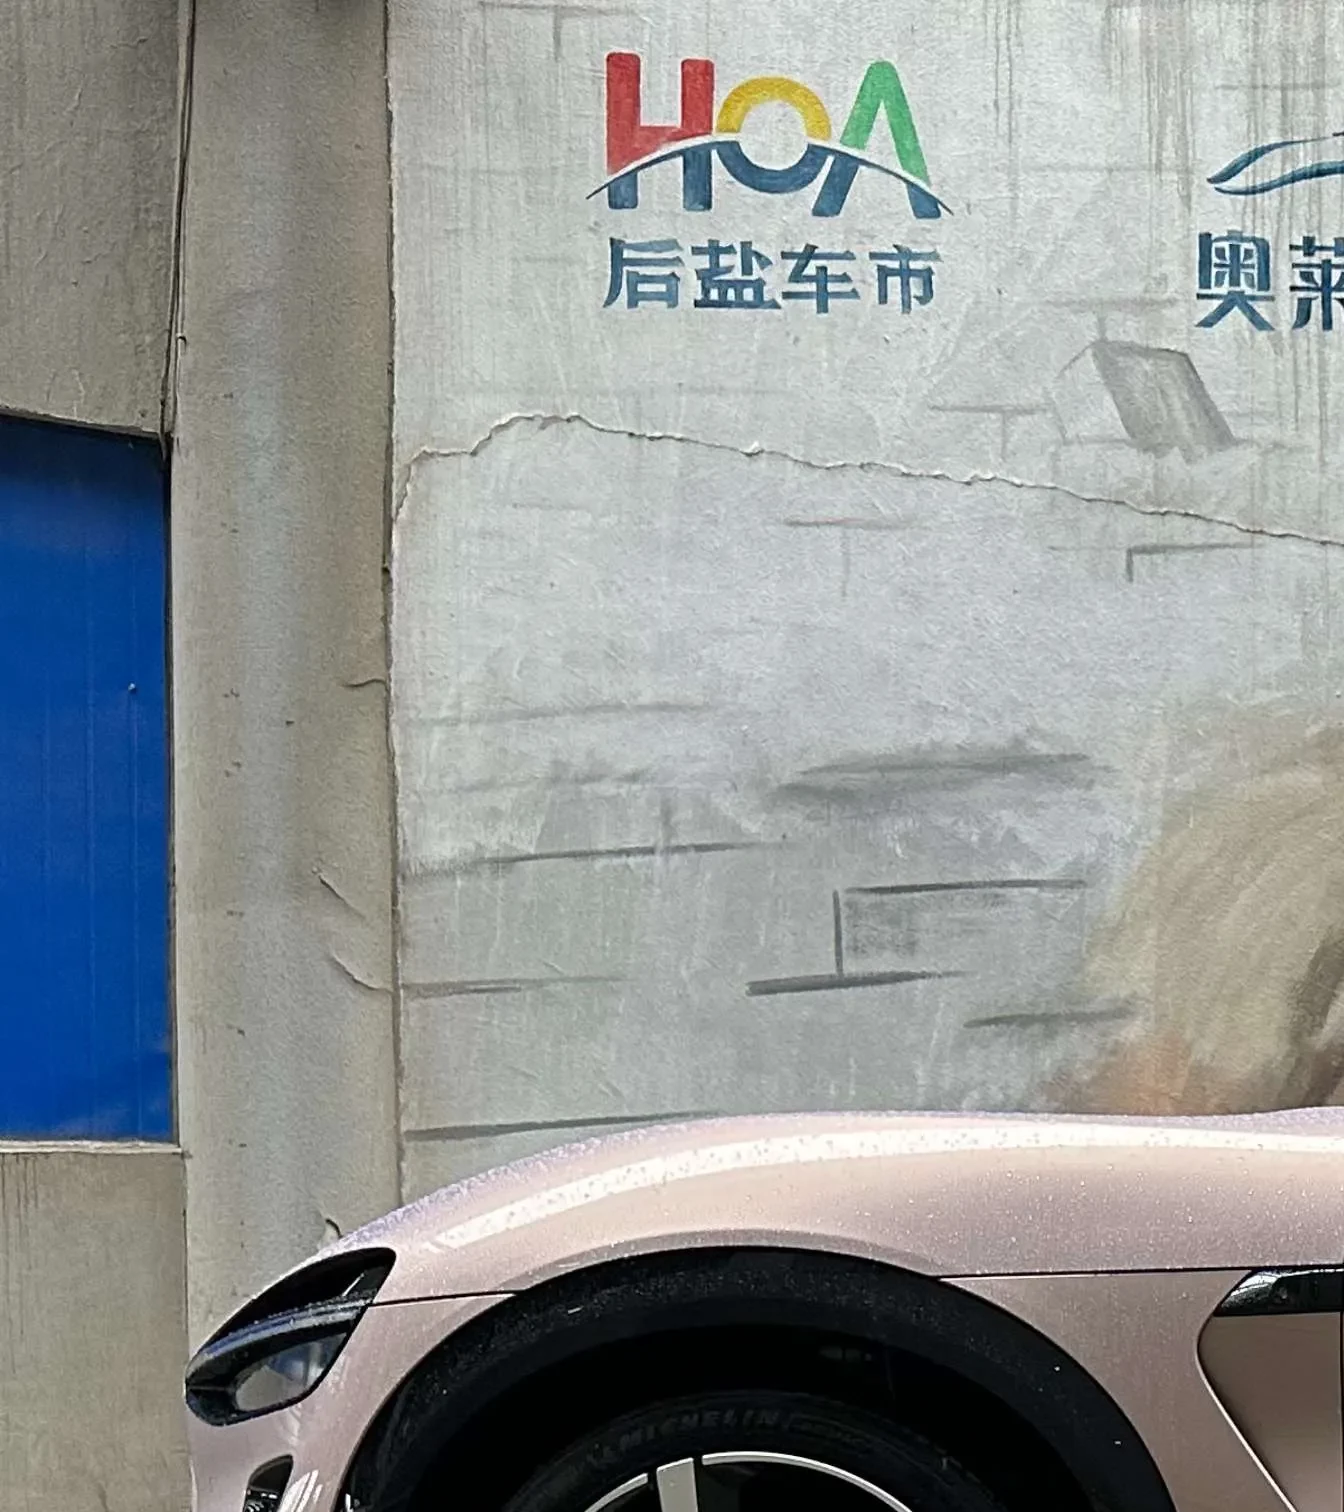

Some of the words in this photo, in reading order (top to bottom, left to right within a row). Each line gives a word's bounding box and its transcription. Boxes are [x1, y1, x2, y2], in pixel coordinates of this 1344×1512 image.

[605, 51, 942, 219] HOA
[602, 236, 943, 314] 后盐车市
